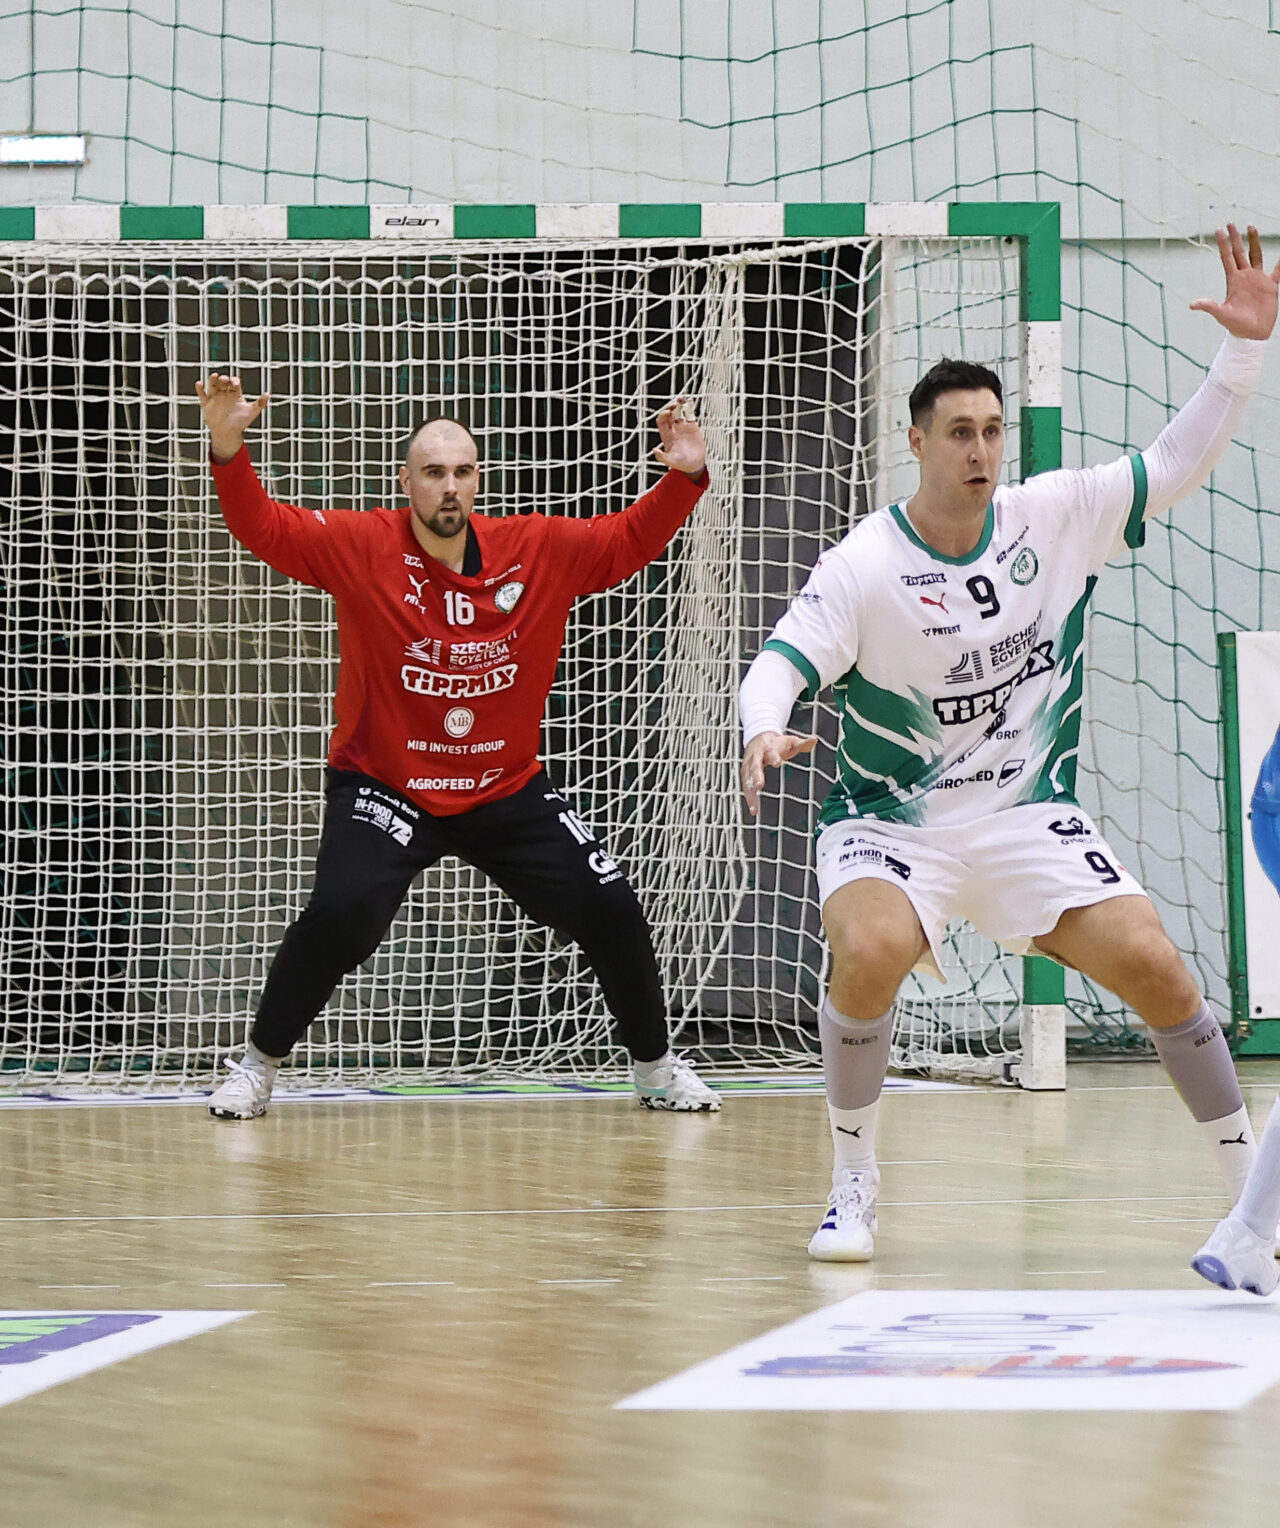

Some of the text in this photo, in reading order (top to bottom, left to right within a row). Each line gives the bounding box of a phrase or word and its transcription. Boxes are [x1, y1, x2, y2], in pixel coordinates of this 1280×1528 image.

[385, 215, 440, 227] elan
[443, 590, 475, 626] 16
[966, 575, 1000, 619] 9
[989, 609, 1042, 655] SZÉCHE
[449, 643, 510, 666] EGYETEM
[406, 740, 505, 755] MIB INVEST GROUP
[405, 778, 475, 790] AGROFEED
[354, 798, 393, 820] IN-FOOD
[1084, 851, 1121, 884] 9
